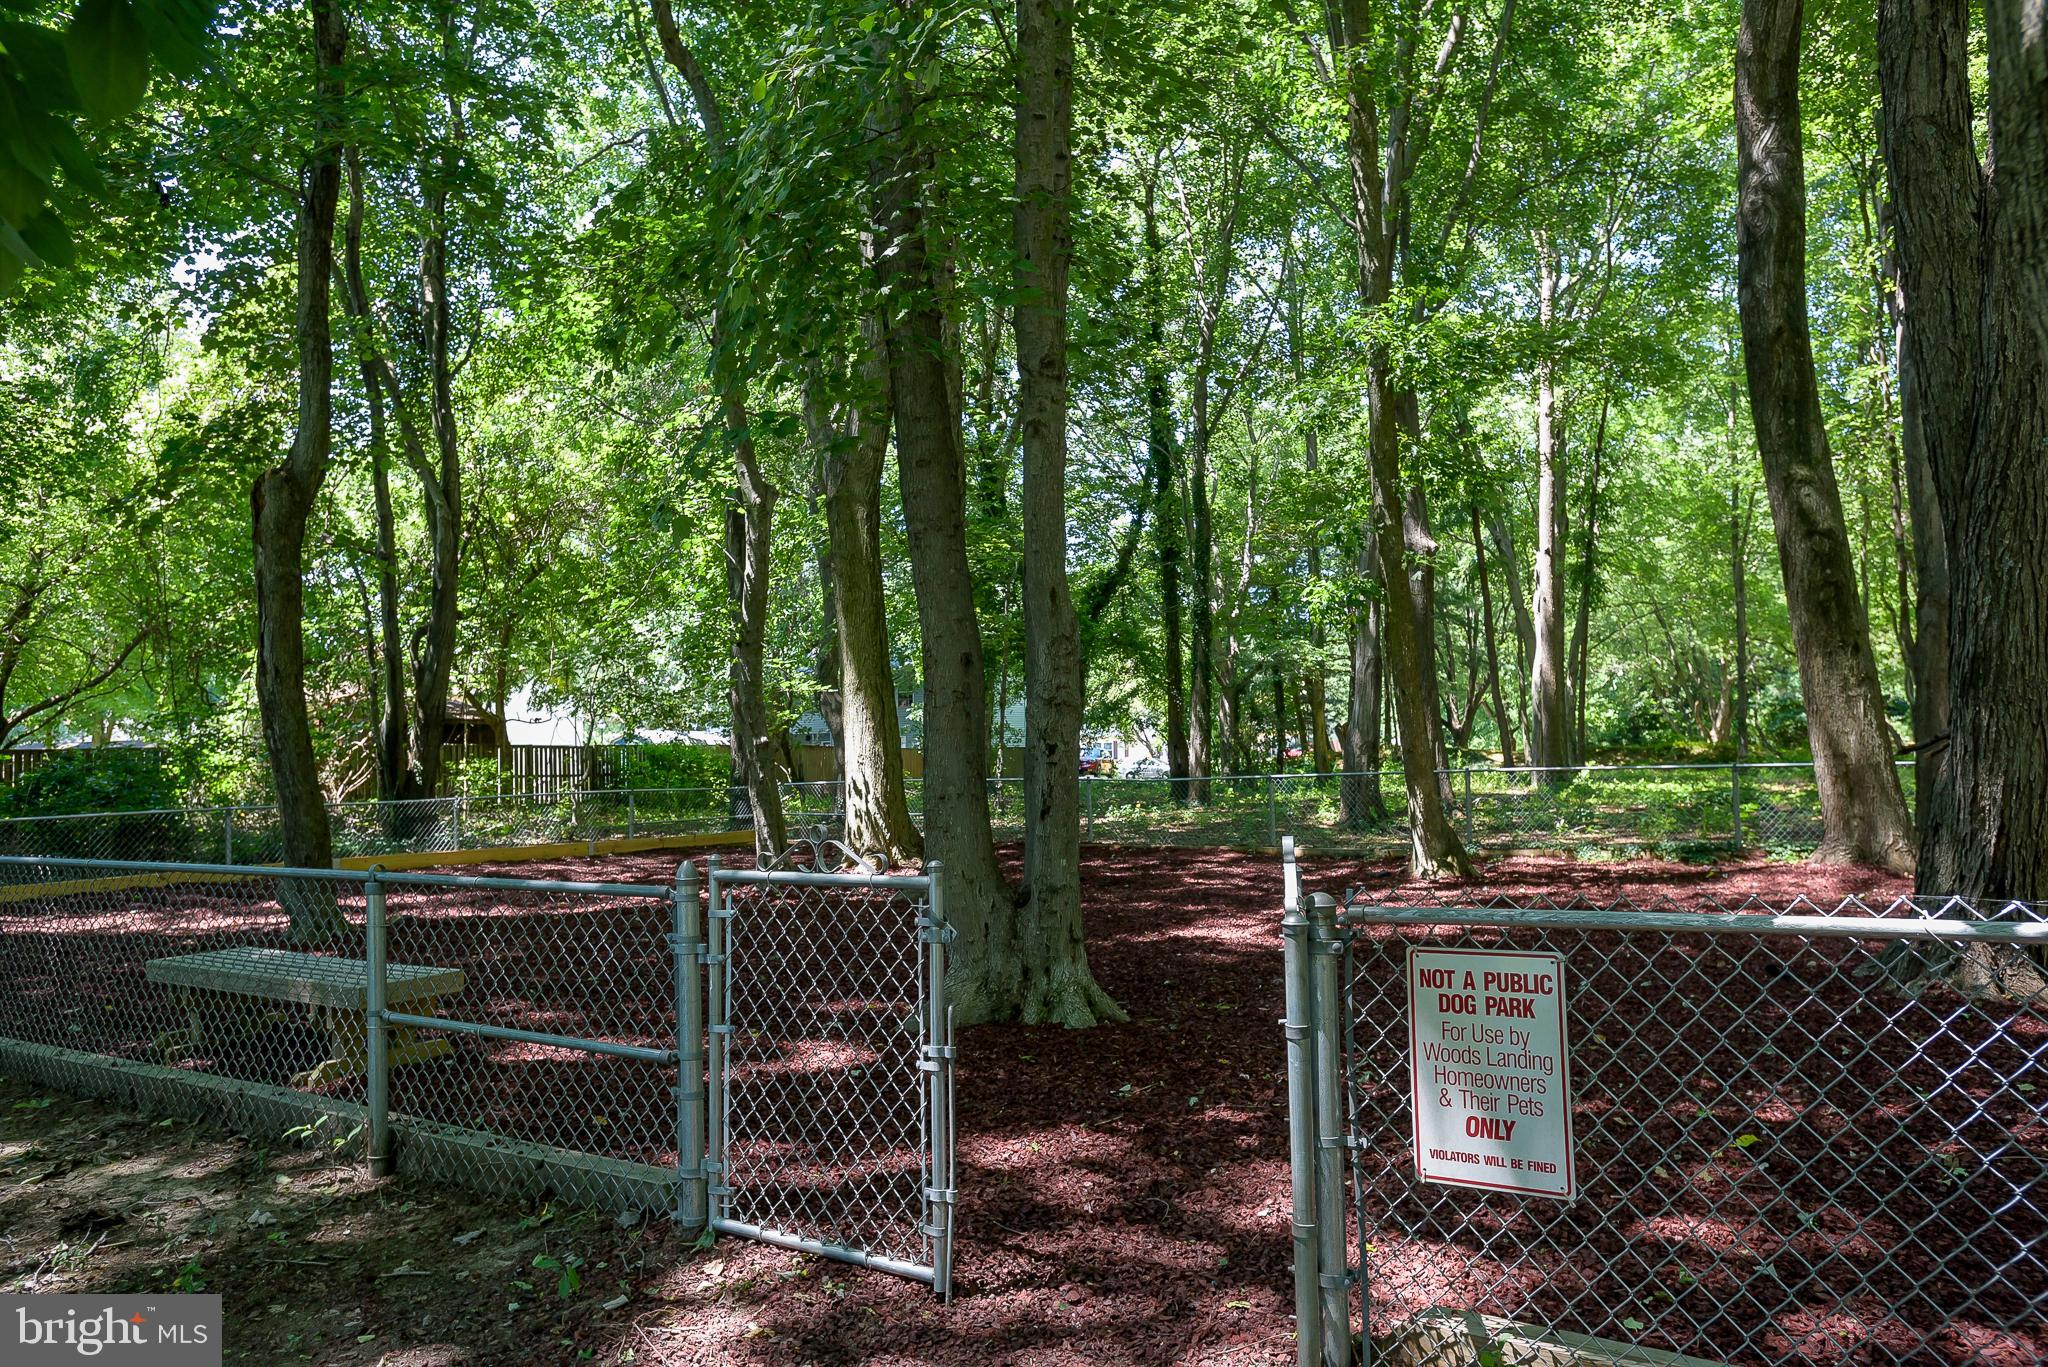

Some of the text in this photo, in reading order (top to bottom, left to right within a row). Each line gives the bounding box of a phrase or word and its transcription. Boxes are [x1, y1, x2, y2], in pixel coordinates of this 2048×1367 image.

[1419, 968, 1553, 996] NOT A PUBLIC
[1438, 993, 1536, 1019] DOG PARK
[1441, 1021, 1530, 1050] For Use by
[1423, 1042, 1553, 1076] Woods Landing
[1434, 1065, 1547, 1095] Homeowners
[1439, 1087, 1544, 1117] & Their Pets
[1465, 1115, 1517, 1142] ONLY
[1429, 1148, 1557, 1174] VIOLATORS WILL BE FINED
